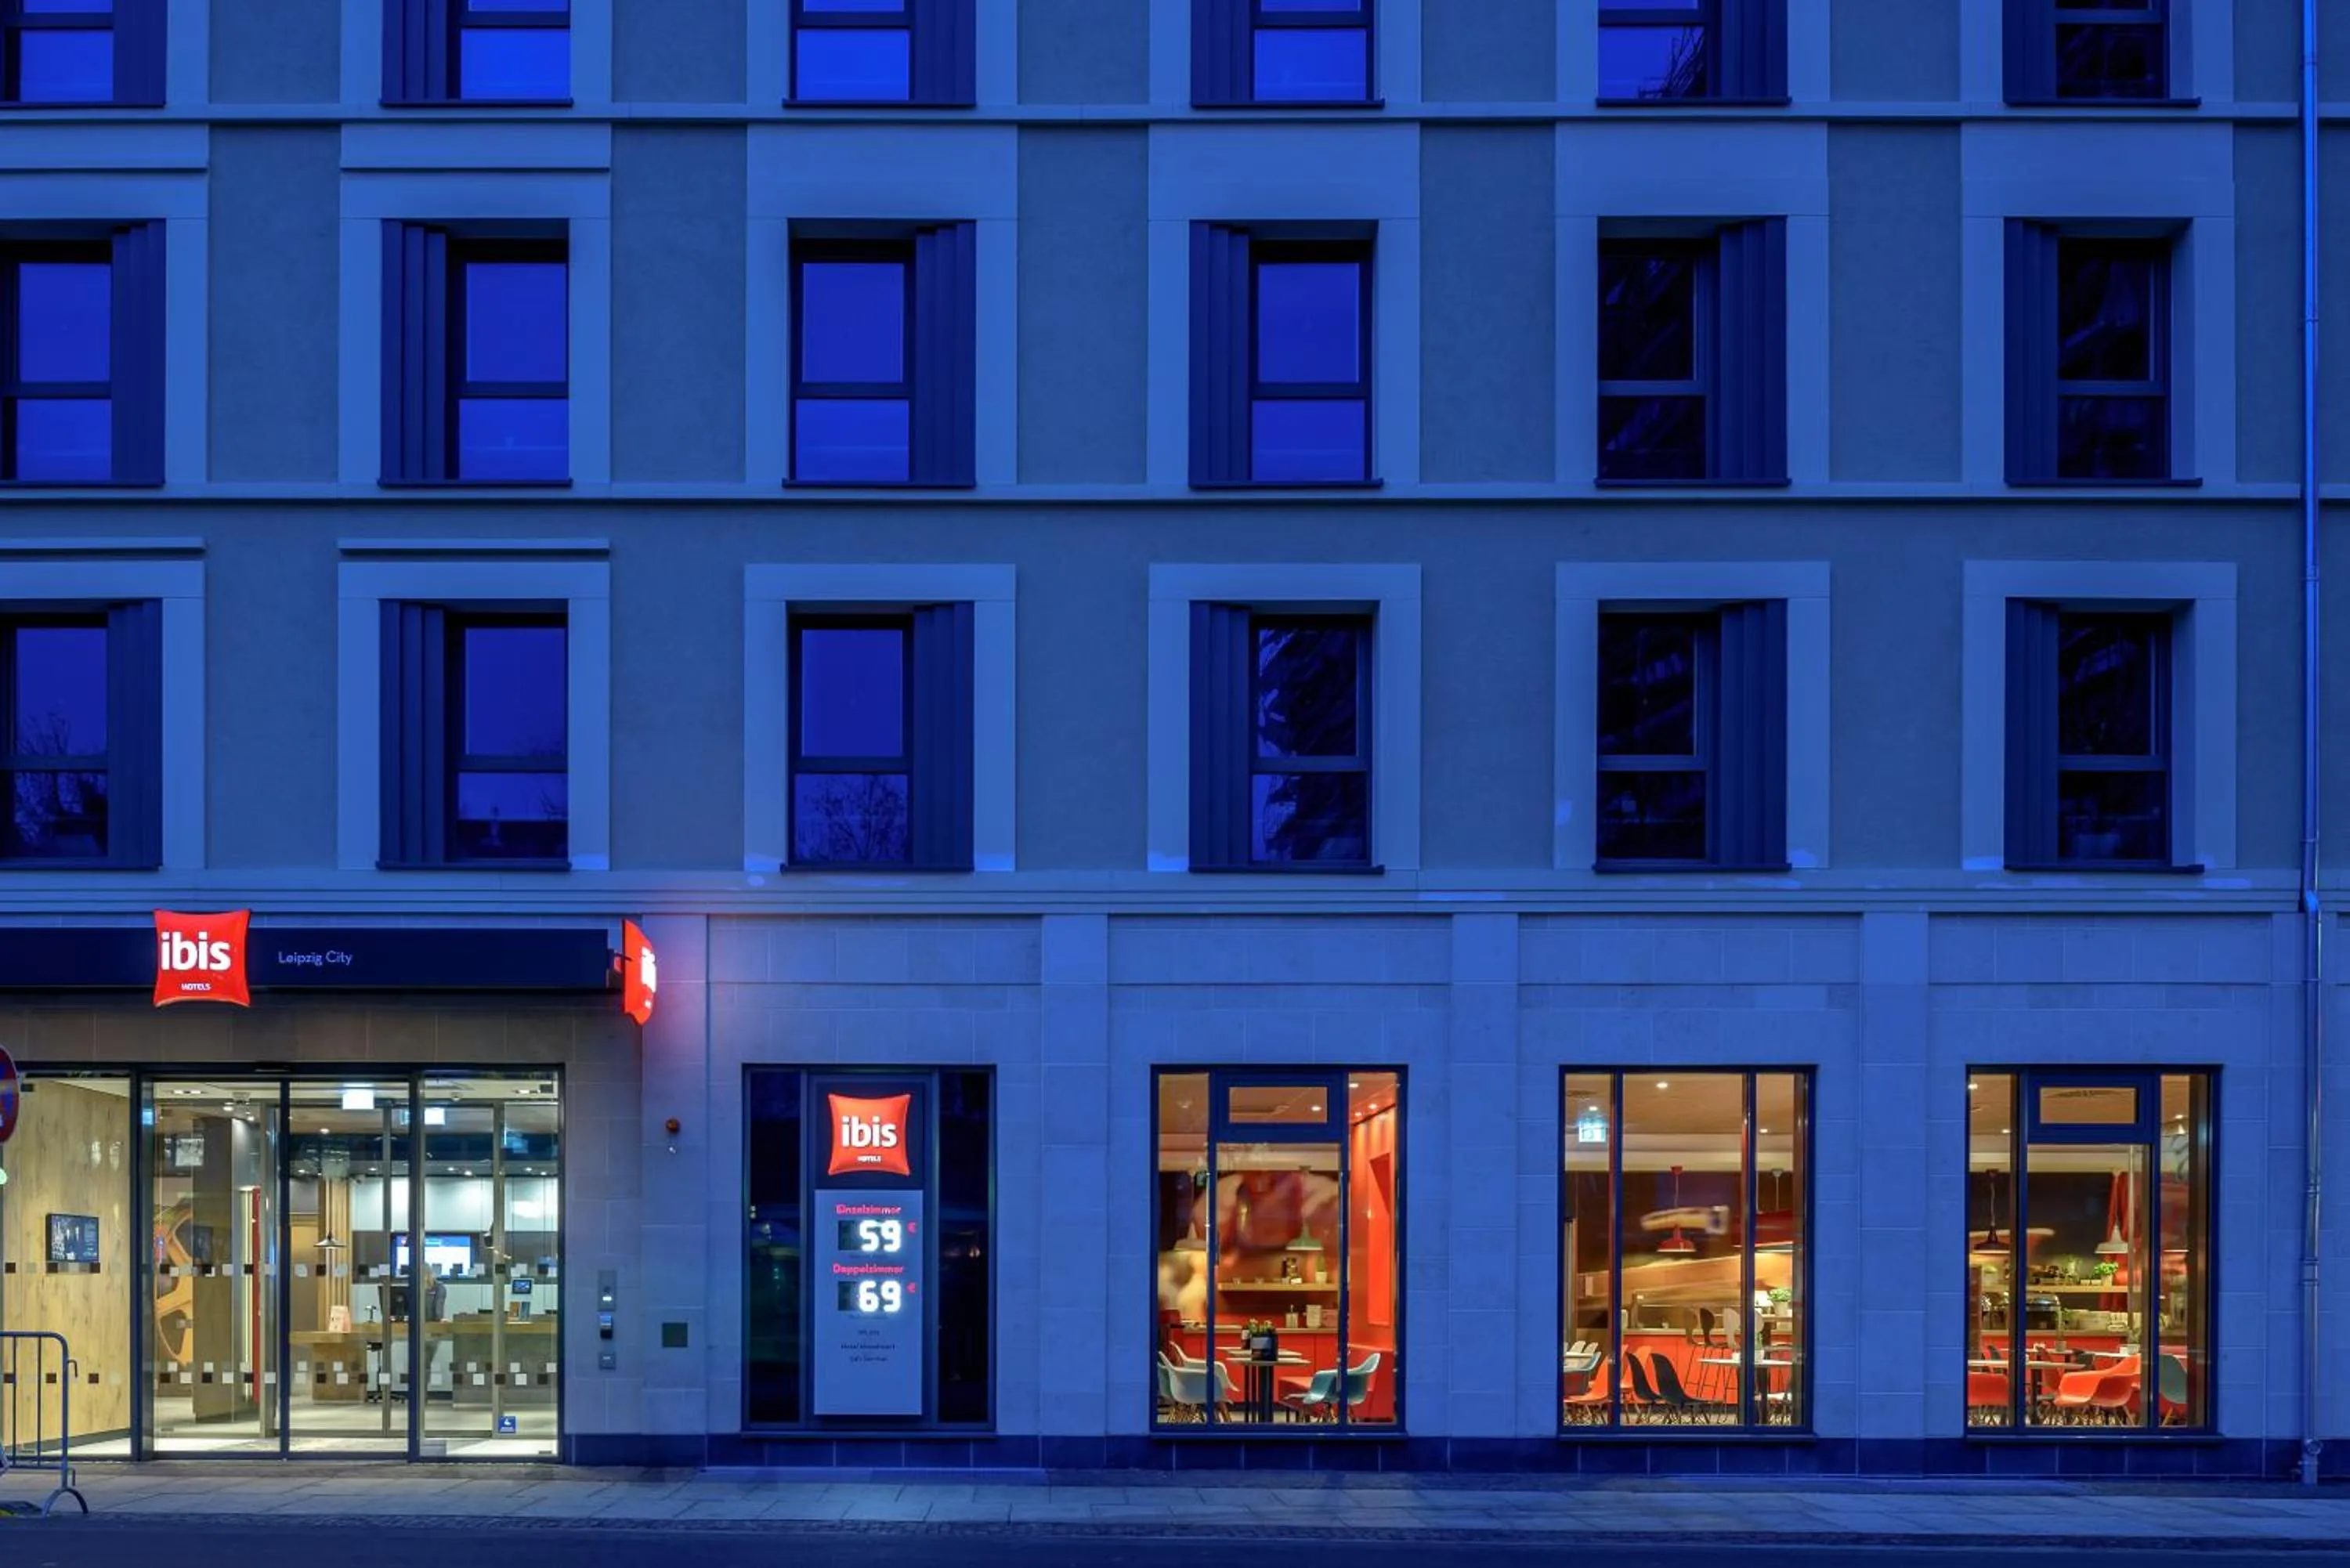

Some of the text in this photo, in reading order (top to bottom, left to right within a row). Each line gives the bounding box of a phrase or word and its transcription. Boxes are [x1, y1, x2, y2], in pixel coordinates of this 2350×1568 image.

[161, 931, 231, 970] ibis
[278, 950, 352, 966] Leipzig City
[842, 1115, 897, 1147] ibis
[859, 1219, 901, 1252] 59
[859, 1280, 901, 1313] 69
